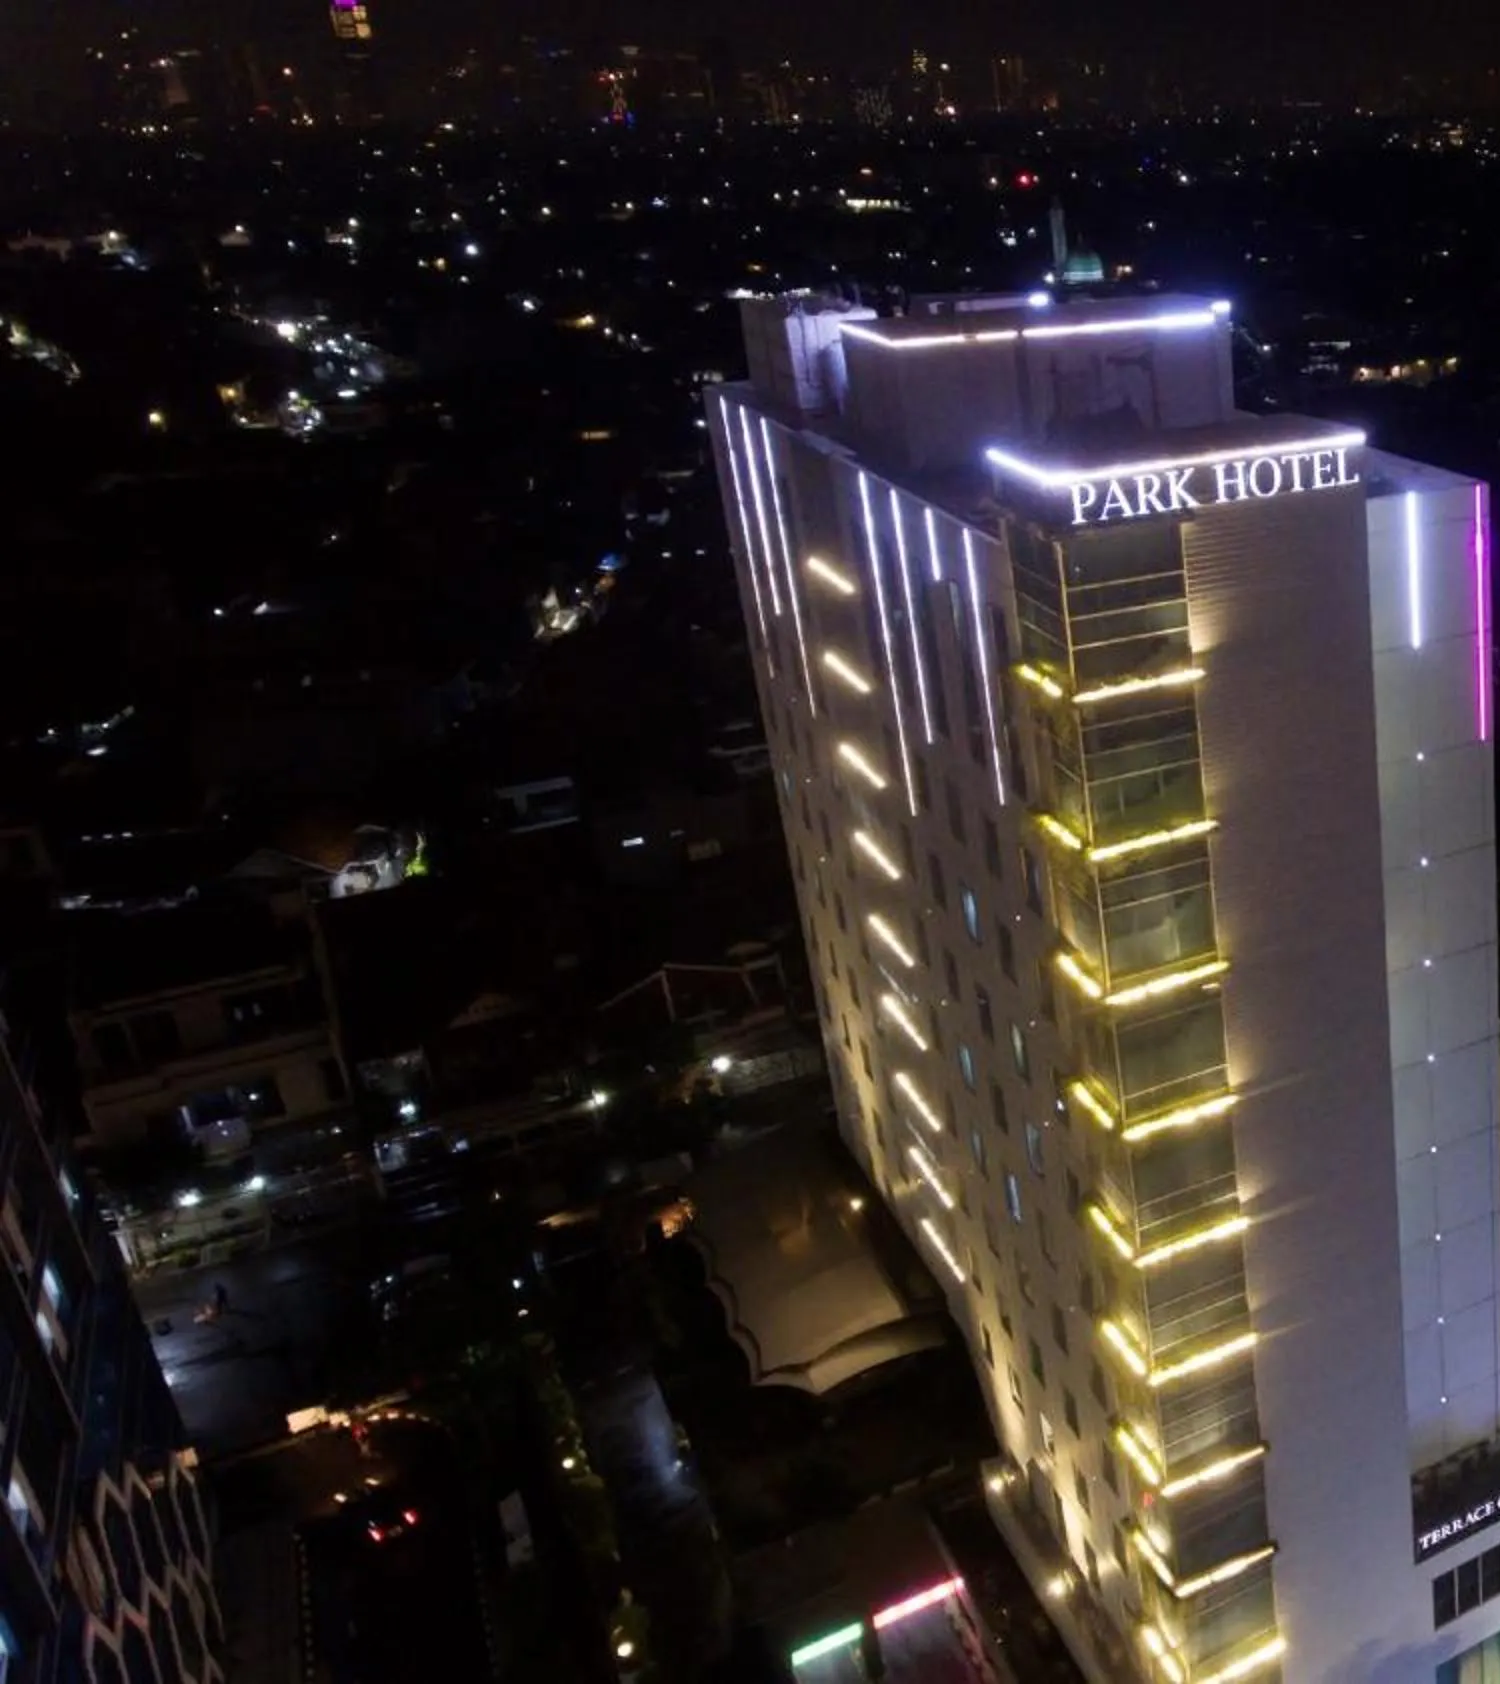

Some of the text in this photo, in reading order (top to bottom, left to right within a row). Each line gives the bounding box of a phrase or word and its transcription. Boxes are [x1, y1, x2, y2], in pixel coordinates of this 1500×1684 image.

[1069, 447, 1361, 525] PARK HOTEL
[1419, 1501, 1495, 1550] TERRACE
